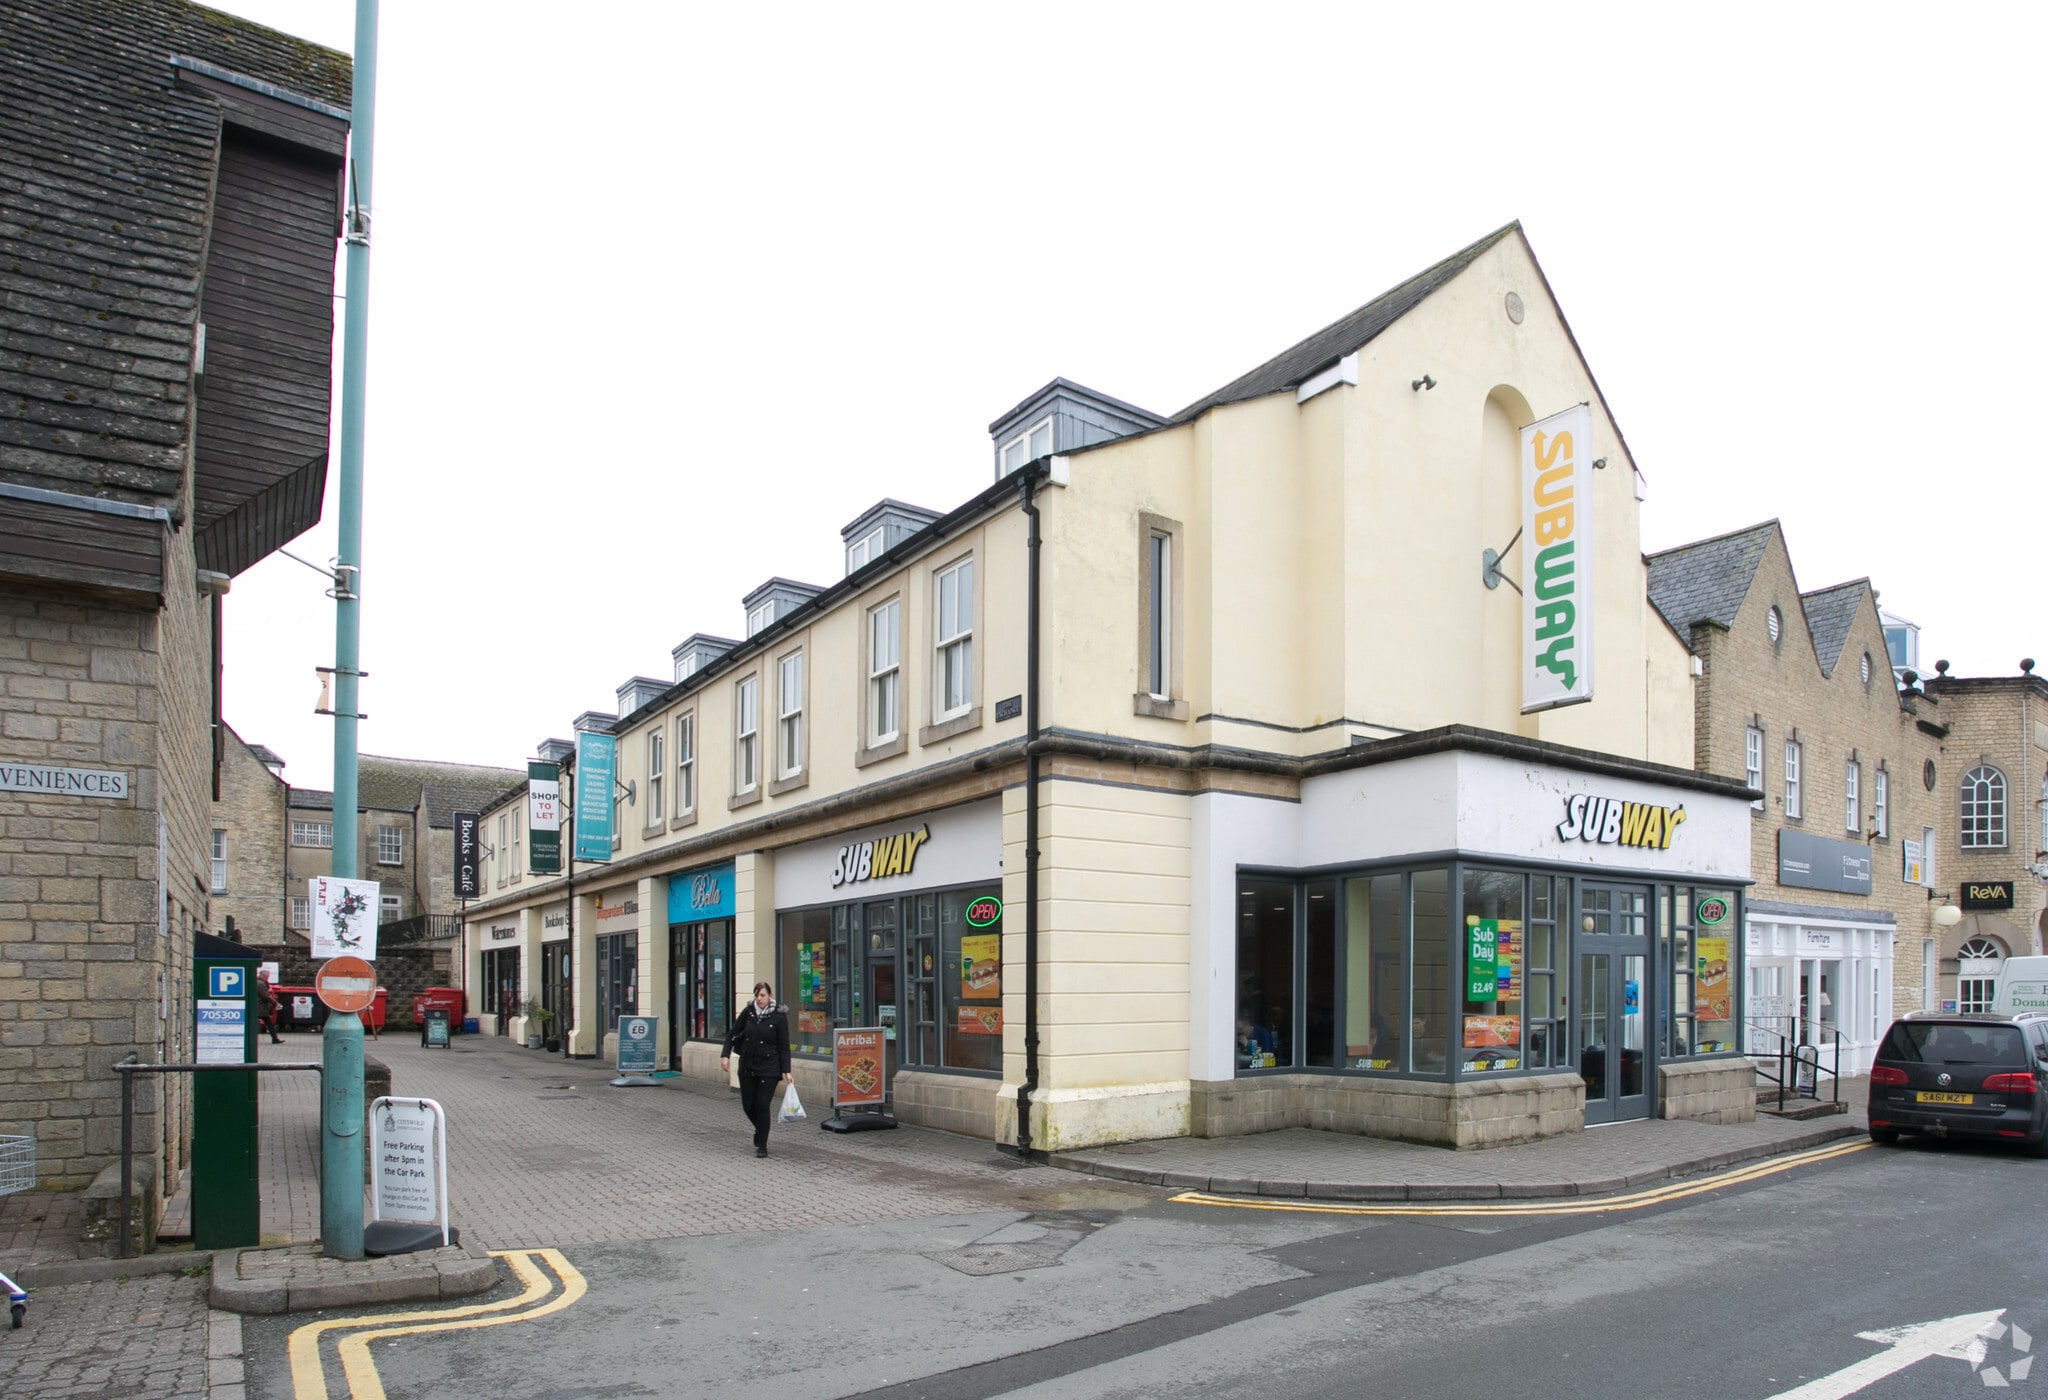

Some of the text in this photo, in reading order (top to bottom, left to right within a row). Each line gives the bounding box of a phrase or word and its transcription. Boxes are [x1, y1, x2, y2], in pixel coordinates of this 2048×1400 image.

[1531, 429, 1577, 691] SUBWAY
[0, 768, 121, 793] VENIENCES
[1556, 794, 1687, 850] SUBWAY
[462, 820, 473, 854] Books
[831, 824, 930, 889] SUBWAY
[462, 865, 473, 891] Café
[691, 874, 720, 910] Bella
[1970, 886, 2007, 899] ReVA
[970, 904, 997, 919] OPEN
[1702, 903, 1724, 918] OPEN
[545, 912, 564, 930] Bookshop
[1473, 927, 1494, 942] Sub
[1807, 931, 1830, 944] Furniture
[1473, 943, 1494, 962] Day
[219, 972, 240, 992] P
[1473, 982, 1494, 993] £2.49
[2012, 998, 2048, 1007] Dona
[202, 1011, 240, 1020] 705300
[632, 1026, 645, 1034] £8
[1466, 1019, 1489, 1028] Arriba!
[838, 1034, 876, 1045] Arriba!
[1356, 1058, 1391, 1069] SUBWAY
[1462, 1061, 1489, 1072] SUBWAY
[1493, 1058, 1519, 1069] SUBWAY
[384, 1141, 424, 1153] Free Parking
[384, 1154, 424, 1164] after 3pm in
[385, 1167, 425, 1178] the Car Park
